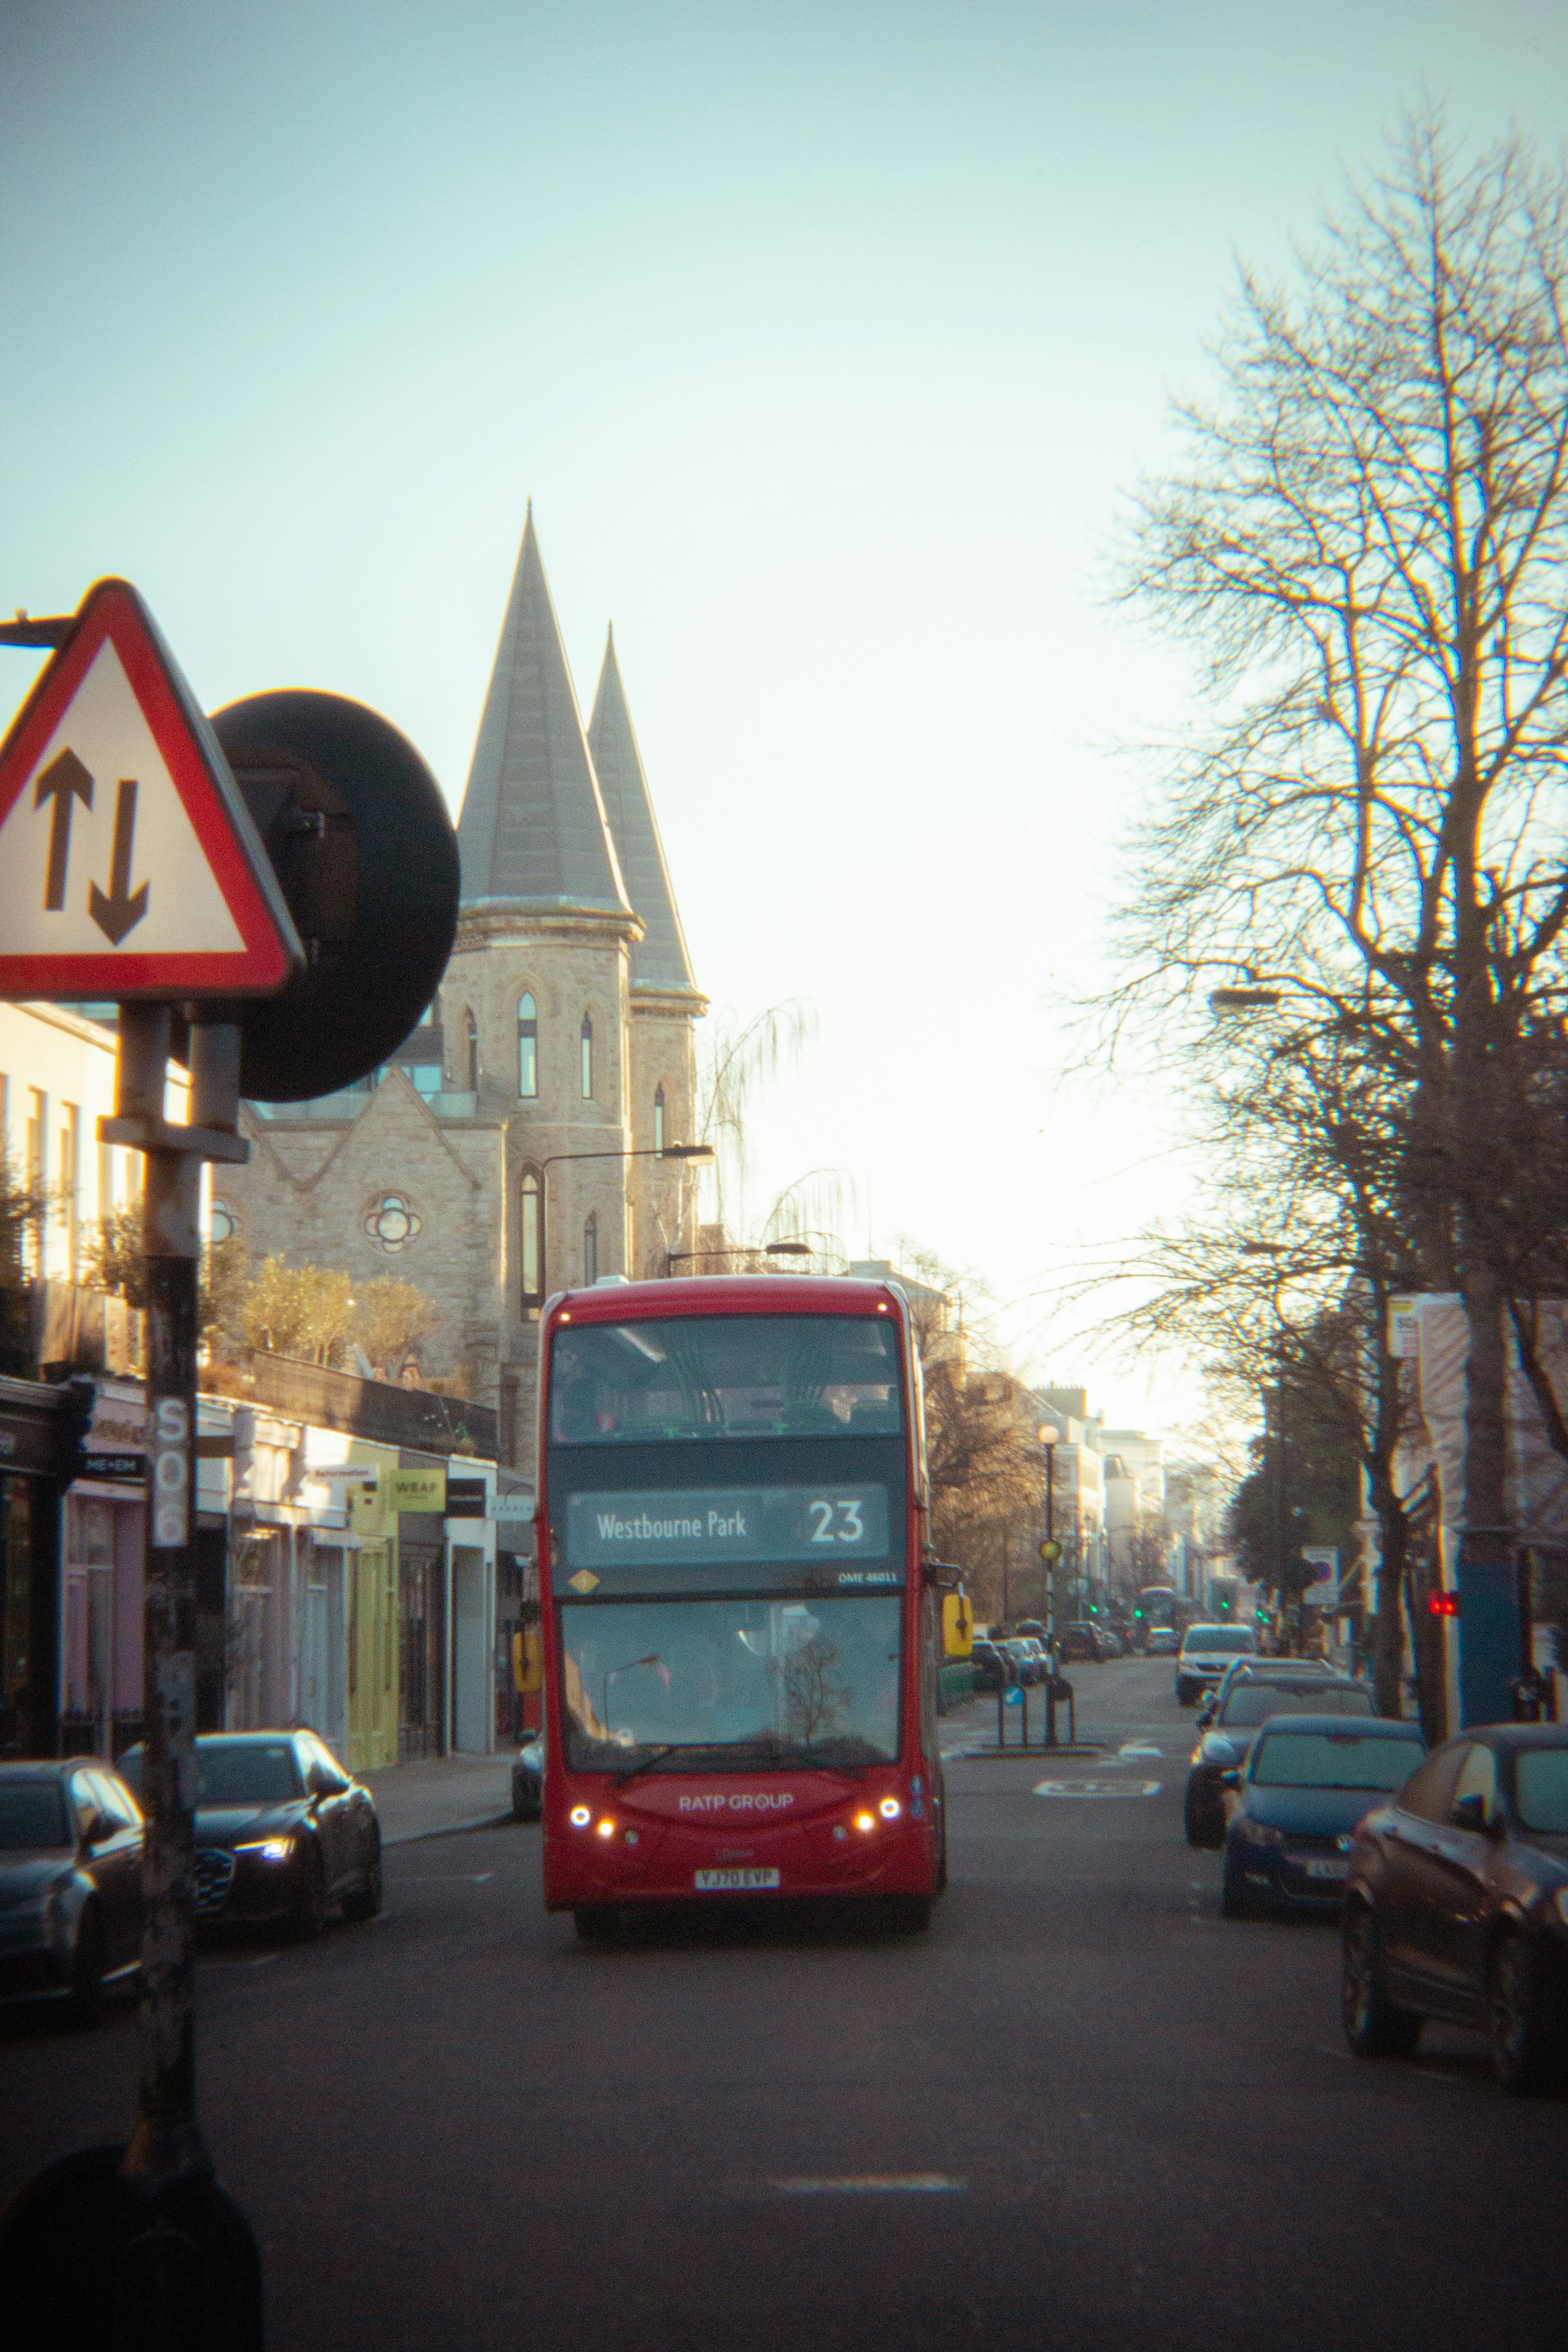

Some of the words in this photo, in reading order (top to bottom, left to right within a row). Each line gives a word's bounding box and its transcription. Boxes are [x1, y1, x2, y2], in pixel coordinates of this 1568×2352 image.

[396, 1482, 438, 1493] WRAP
[597, 1512, 702, 1540] Westbourne
[707, 1510, 748, 1537] Park
[809, 1500, 864, 1543] 23
[678, 1795, 725, 1812] RATP
[729, 1793, 794, 1810] GROUP
[701, 1871, 739, 1886] YJ70
[743, 1870, 772, 1885] EVP
